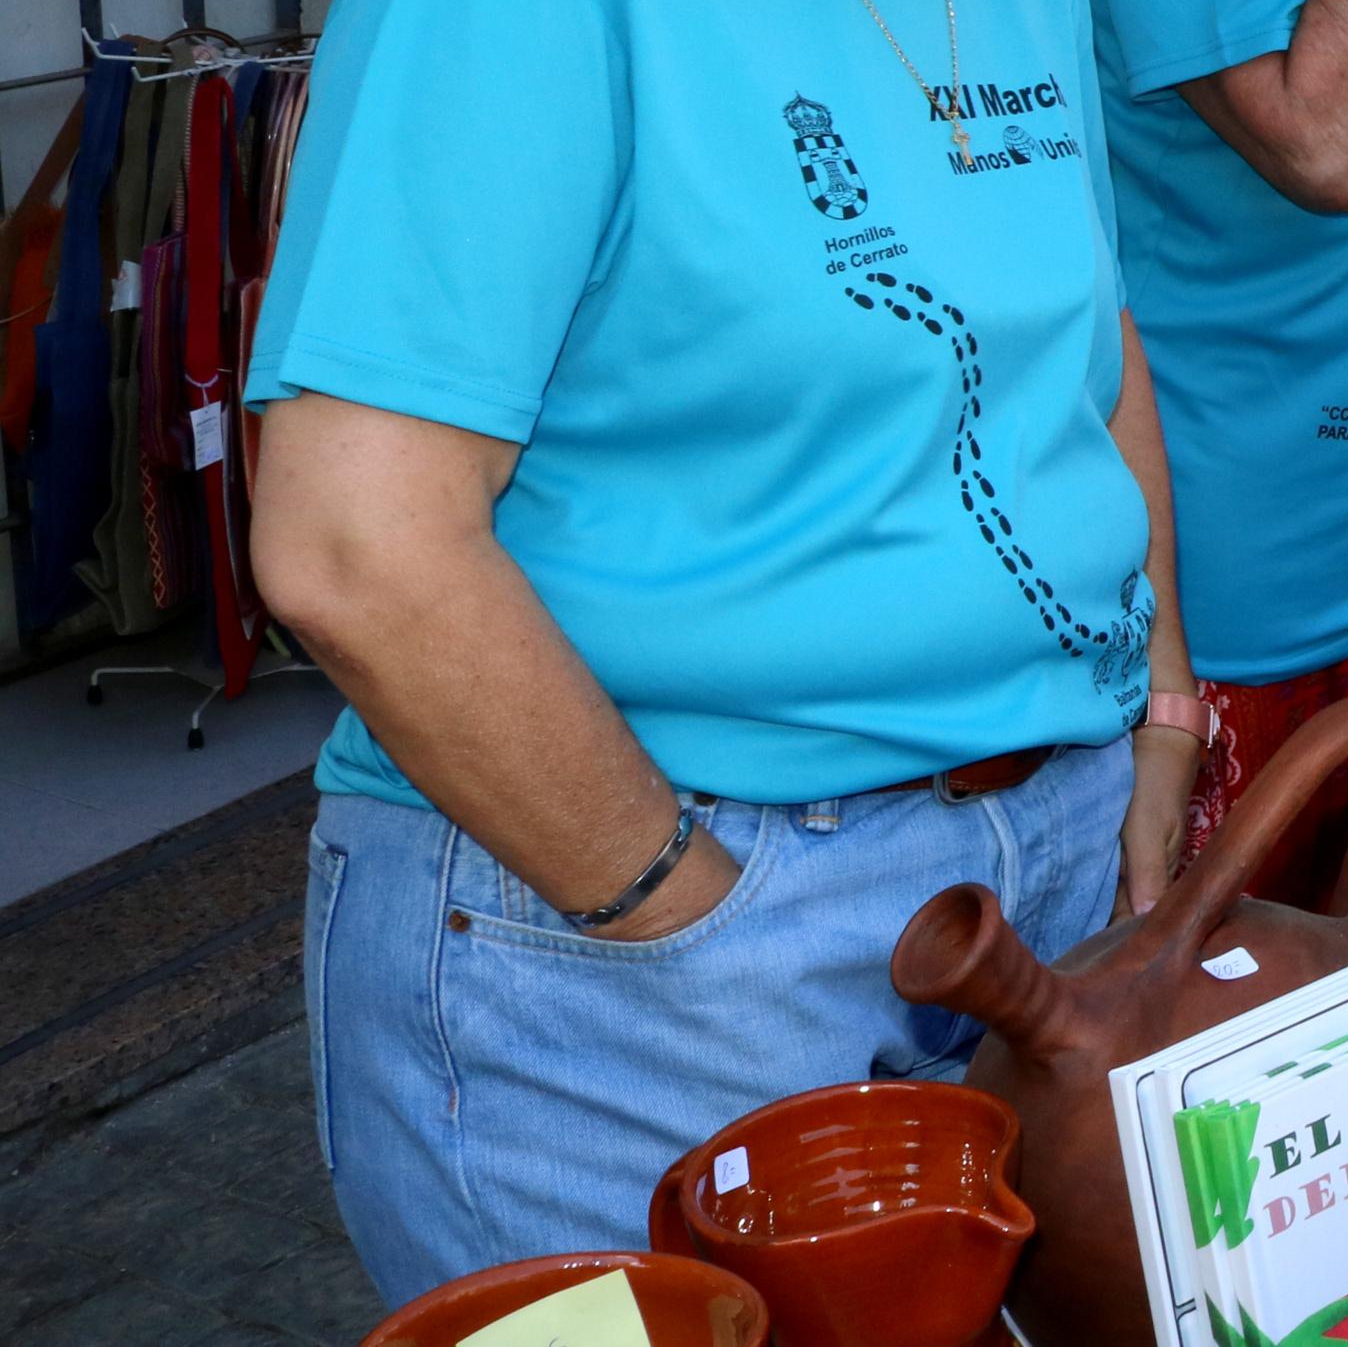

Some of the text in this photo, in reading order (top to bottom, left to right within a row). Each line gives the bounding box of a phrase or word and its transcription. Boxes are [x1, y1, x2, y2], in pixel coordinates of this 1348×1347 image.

[928, 82, 977, 122] XXI
[948, 149, 1011, 175] Manos
[825, 225, 896, 254] Hornillos
[825, 242, 909, 276] de Cerrato
[1264, 1113, 1342, 1179] EL
